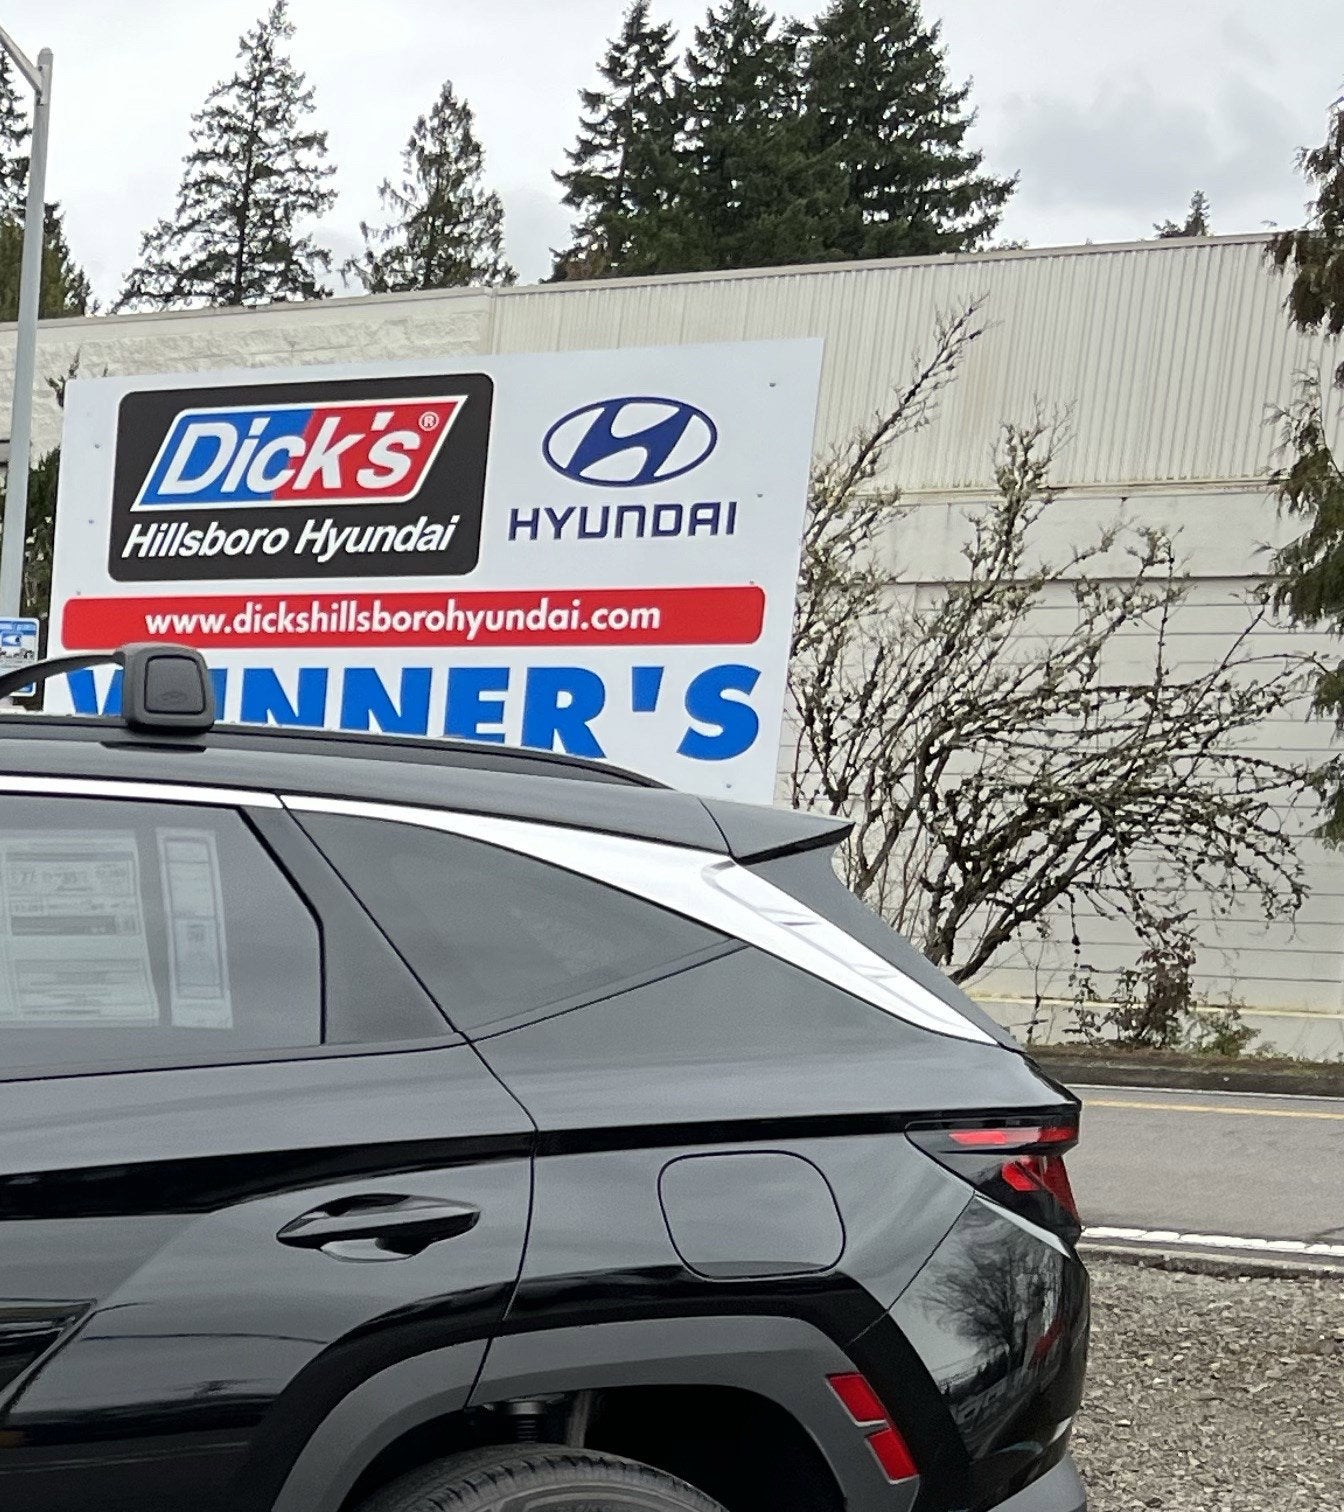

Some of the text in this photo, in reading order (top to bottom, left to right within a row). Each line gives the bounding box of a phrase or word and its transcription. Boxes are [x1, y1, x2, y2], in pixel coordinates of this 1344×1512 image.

[121, 514, 460, 563] Hillsboro Hyundai
[508, 501, 738, 541] HYUNDAI
[144, 597, 662, 640] www.dickshillsborohyundai.com
[66, 663, 762, 761] NNER'S
